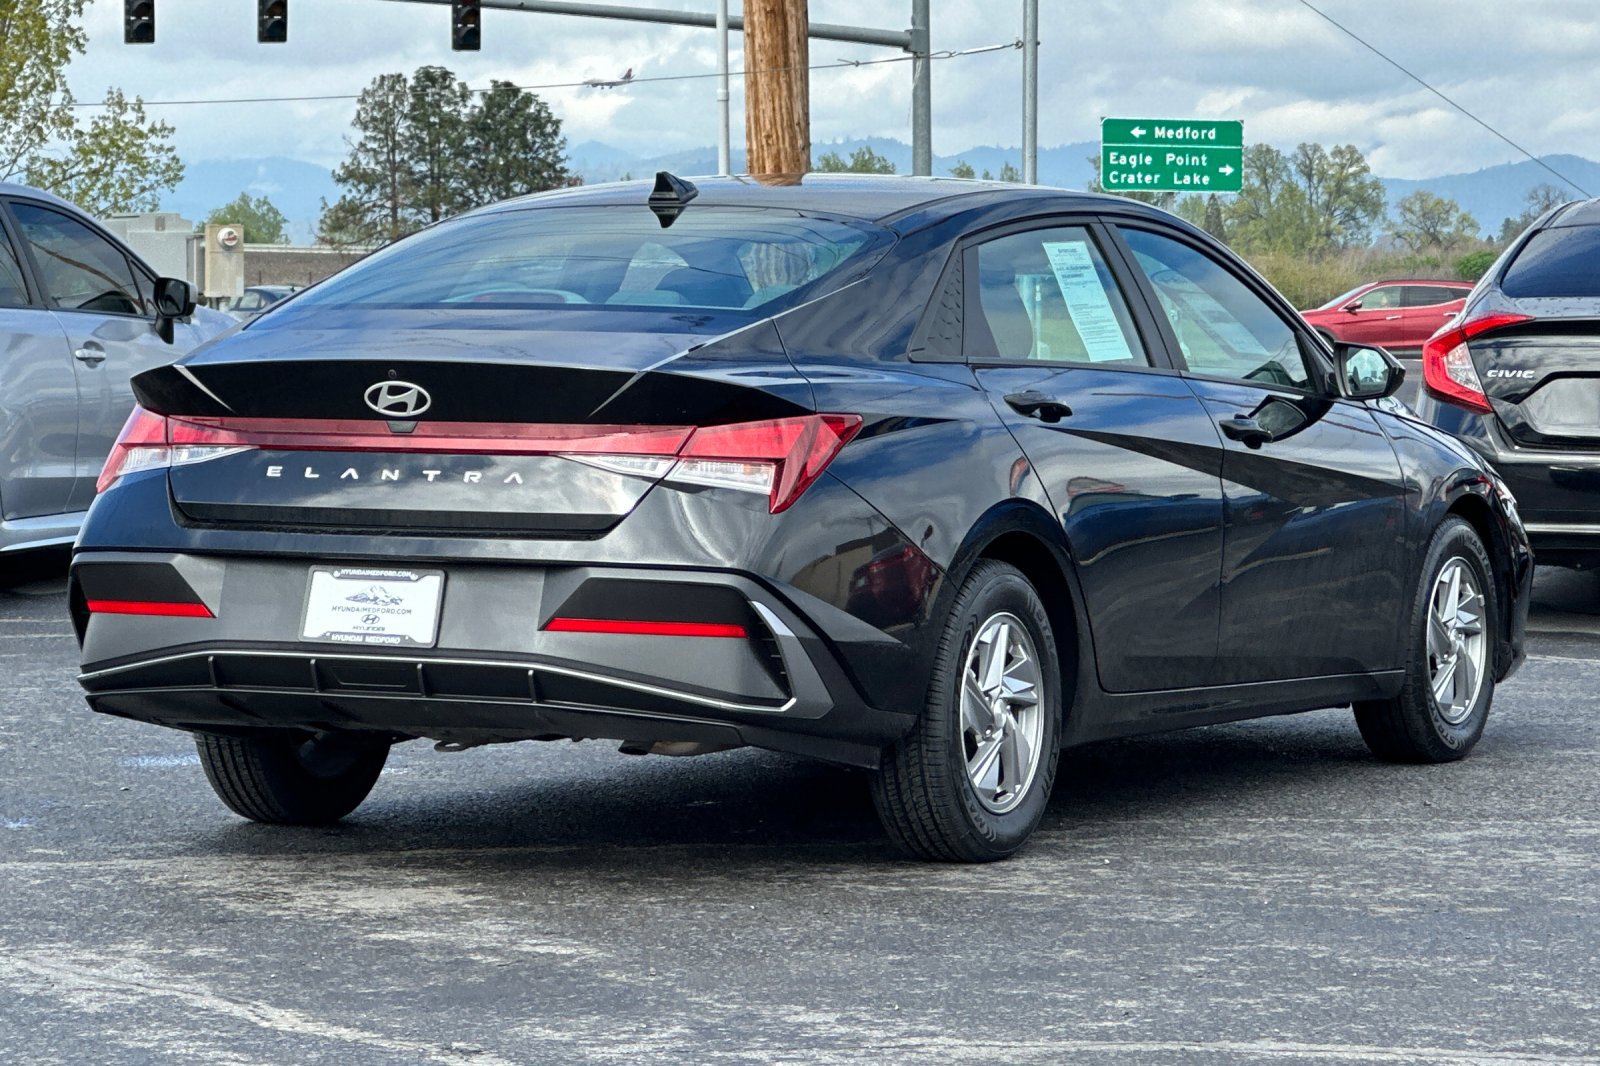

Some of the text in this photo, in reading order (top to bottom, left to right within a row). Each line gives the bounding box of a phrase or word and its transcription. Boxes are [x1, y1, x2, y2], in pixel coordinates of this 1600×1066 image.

[1154, 126, 1216, 140] Medford
[1109, 152, 1208, 168] Eagle Point
[1109, 171, 1210, 185] Crater Lake
[1486, 369, 1535, 379] CIVIC
[266, 465, 523, 485] ELANTRA
[340, 569, 412, 578] HYUNDAIMEDFORD.COM
[331, 605, 412, 615] HYUNDAIMEDFORD.COM
[331, 634, 401, 644] HYUNDAI MEDFORD
